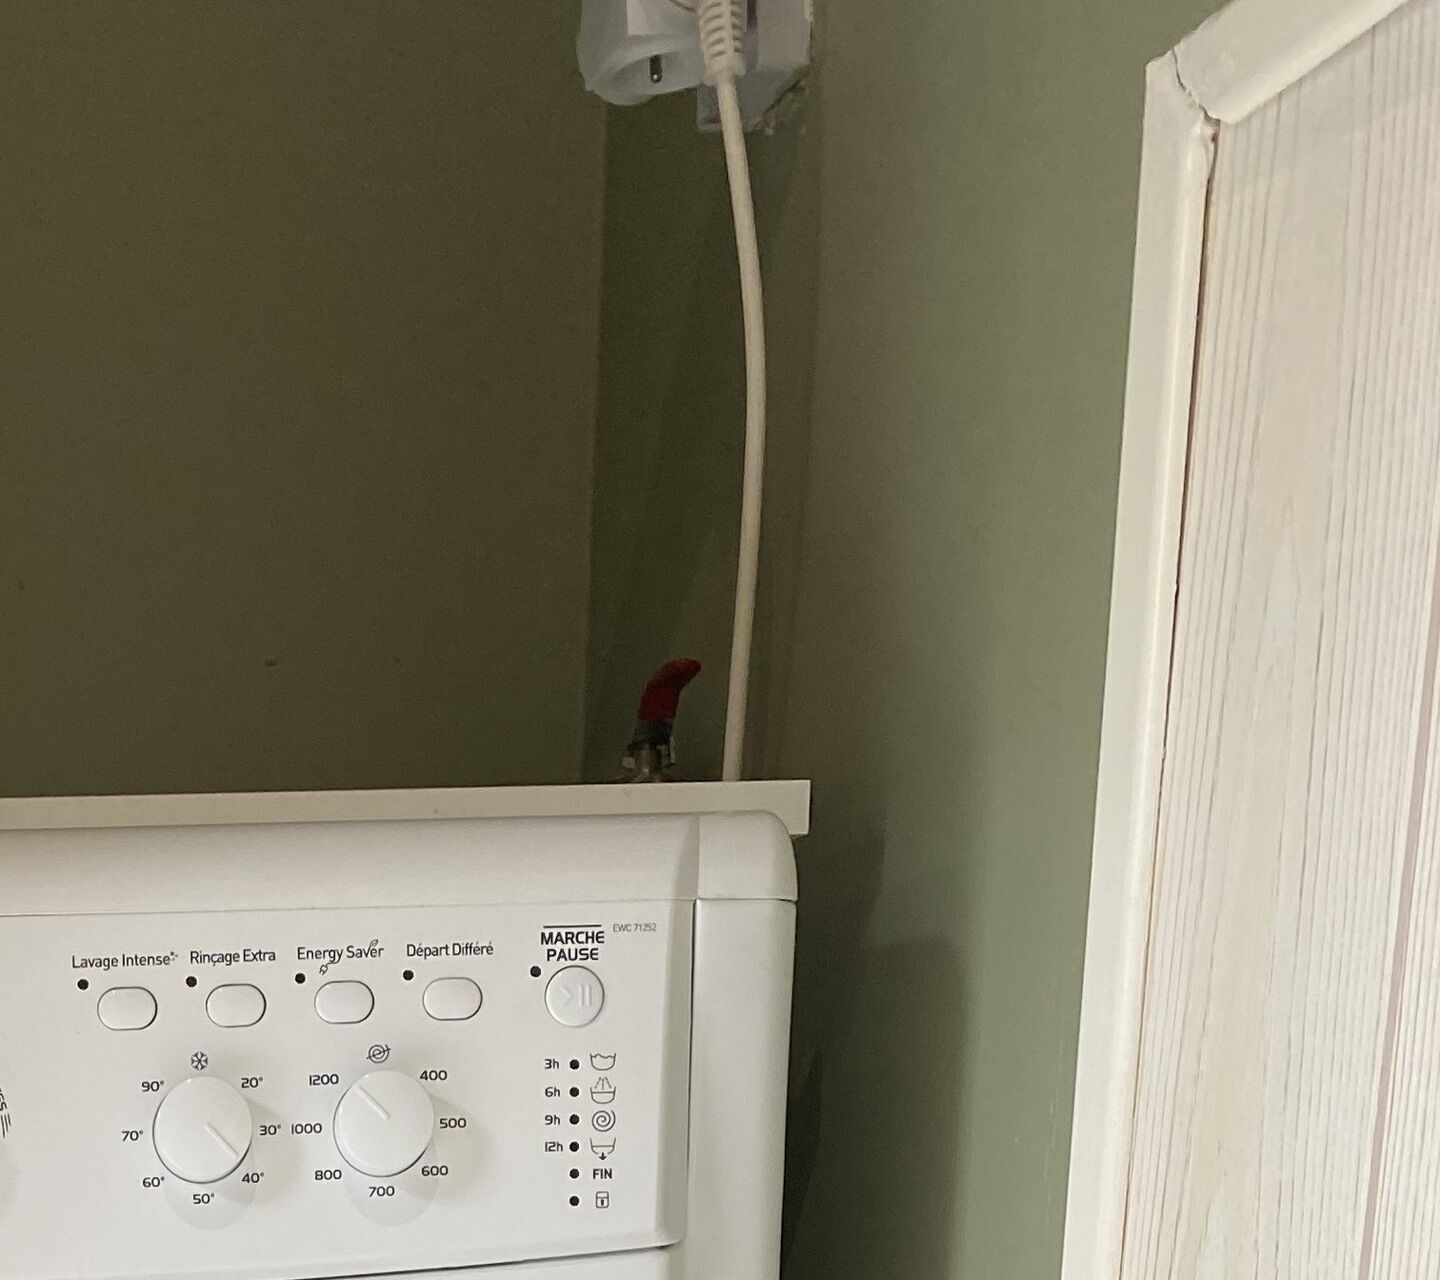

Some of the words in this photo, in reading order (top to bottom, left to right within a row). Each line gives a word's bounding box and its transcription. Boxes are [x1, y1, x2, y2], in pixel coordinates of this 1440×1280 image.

[540, 931, 605, 946] MARCHE
[297, 946, 344, 965] Energy
[346, 945, 385, 959] Saver
[406, 943, 450, 960] Départ
[452, 941, 494, 956] Différé
[546, 948, 599, 962] PAUSE
[72, 955, 118, 971] Lavage
[190, 951, 240, 967] Rinçage
[243, 949, 276, 963] Extra
[544, 1058, 559, 1069] 3h
[308, 1073, 339, 1087] 1200
[419, 1069, 448, 1082] 400
[544, 1086, 560, 1097] 6h
[439, 1117, 467, 1130] 500
[544, 1114, 561, 1125] 9h
[291, 1122, 323, 1136] 1000
[544, 1141, 563, 1152] 12h
[314, 1168, 342, 1181] 800
[421, 1164, 449, 1177] 600
[593, 1168, 612, 1180] FIN
[368, 1185, 396, 1198] 700
